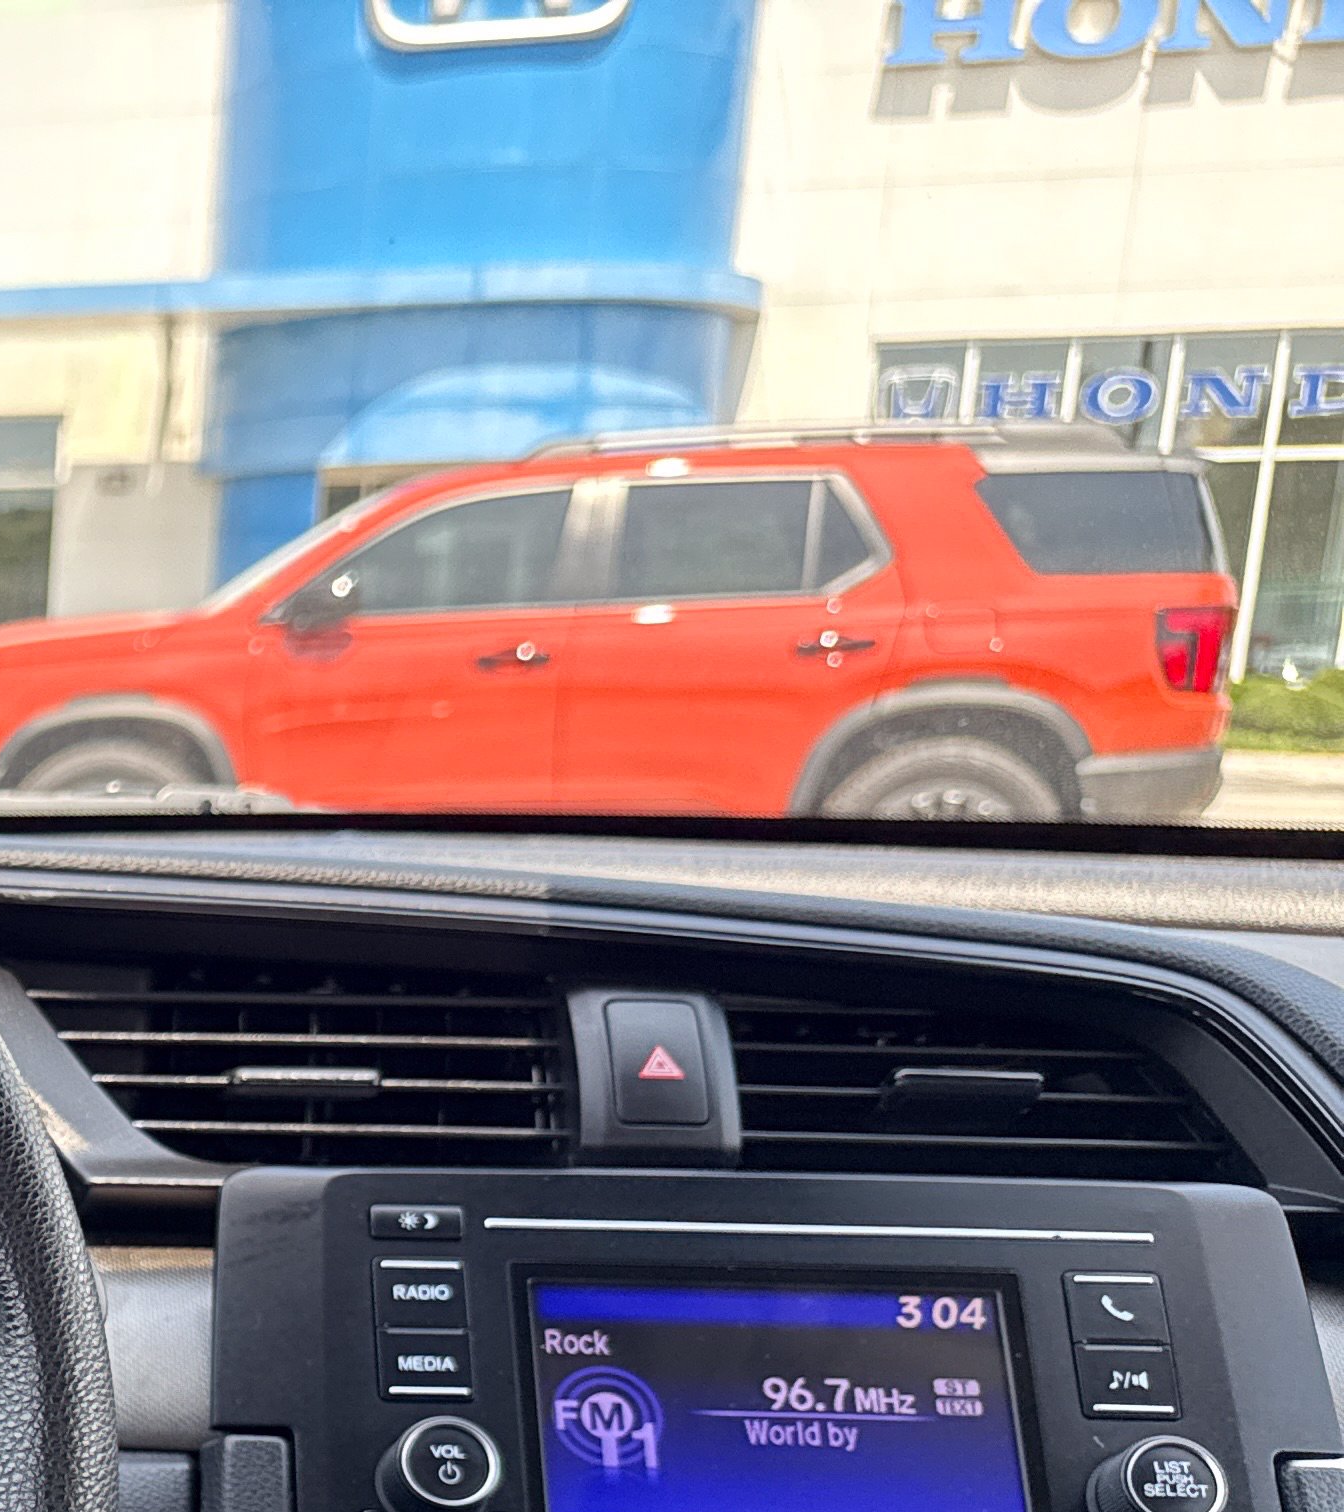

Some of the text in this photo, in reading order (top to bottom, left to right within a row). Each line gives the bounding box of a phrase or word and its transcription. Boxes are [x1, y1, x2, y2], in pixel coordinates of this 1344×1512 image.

[885, 0, 1344, 66] HON
[392, 1283, 453, 1301] RADIO
[543, 1328, 611, 1355] Rock
[397, 1355, 458, 1372] MEDIA
[744, 1418, 859, 1452] World by
[429, 1444, 468, 1460] VOL
[1152, 1461, 1192, 1475] LIST
[1156, 1473, 1195, 1486] PUSH
[1143, 1483, 1209, 1499] SELECT
